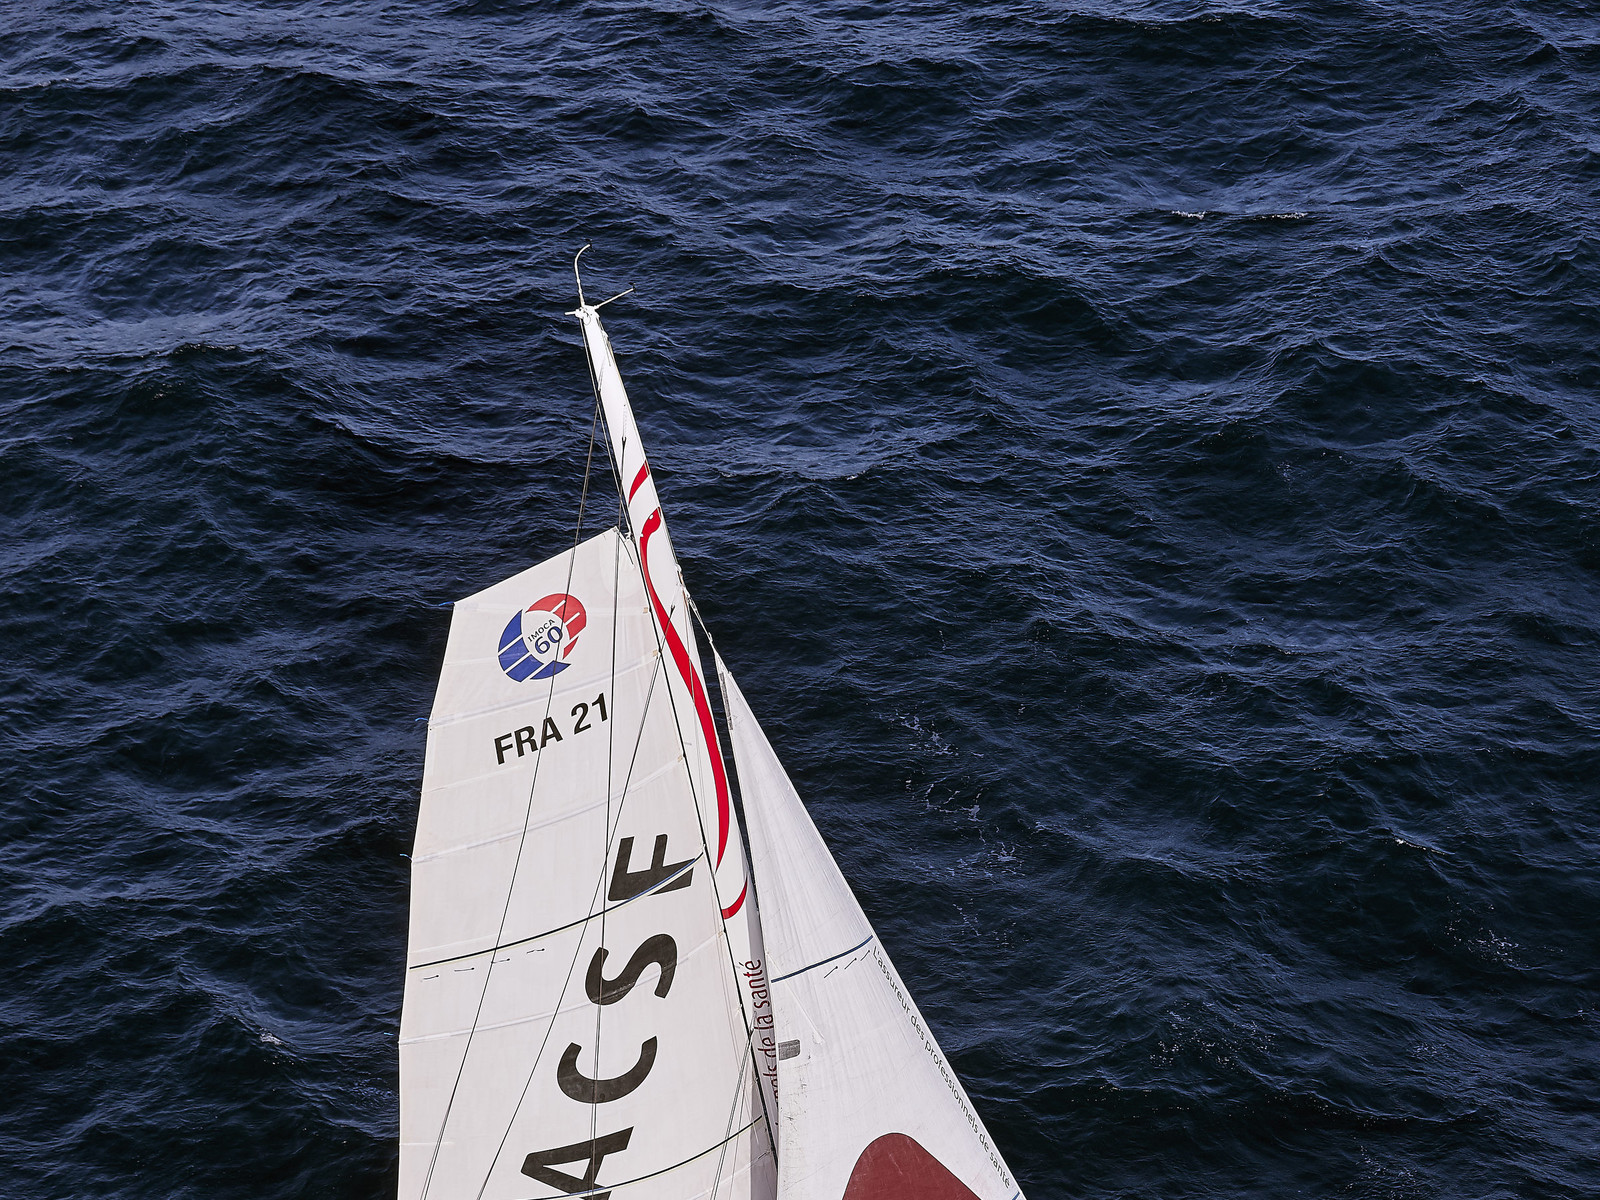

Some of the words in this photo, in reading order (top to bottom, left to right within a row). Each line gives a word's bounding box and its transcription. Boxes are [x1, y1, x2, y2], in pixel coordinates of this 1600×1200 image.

[527, 619, 556, 642] IMOCA
[534, 626, 563, 654] 60
[494, 716, 563, 765] FRA
[570, 692, 608, 735] 21
[739, 959, 770, 1009] santé
[754, 1014, 774, 1030] la
[872, 945, 910, 1014] L'assureur
[911, 1014, 925, 1040] des
[925, 1040, 979, 1134] professionnels
[979, 1132, 989, 1152] de
[989, 1151, 1010, 1189] santé
